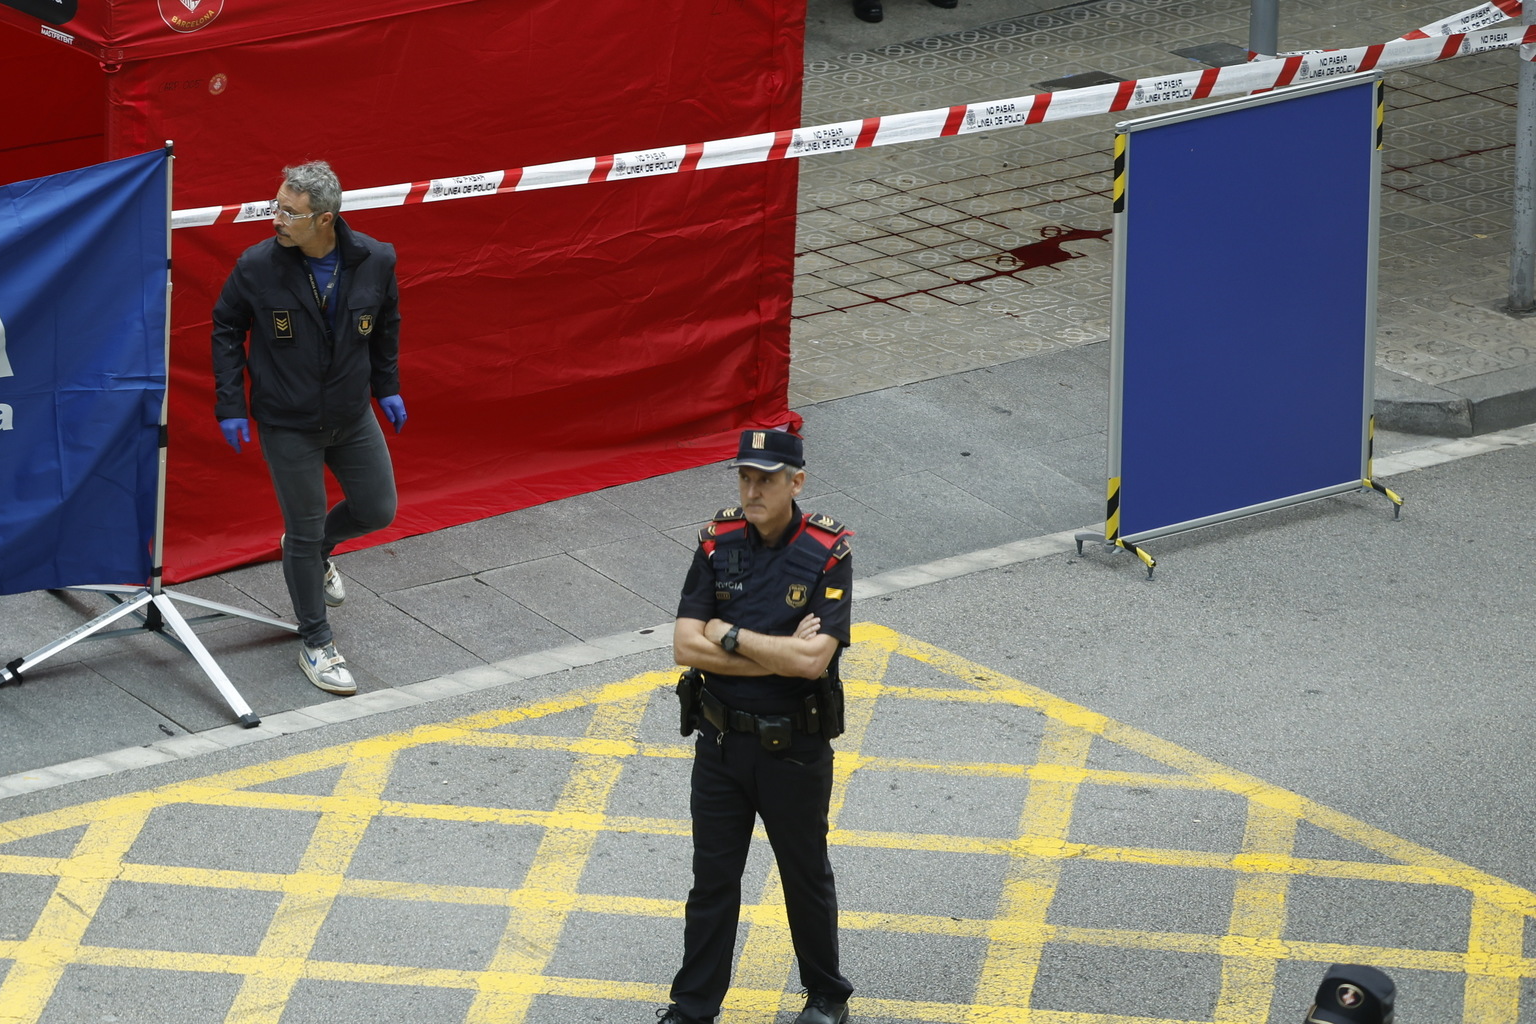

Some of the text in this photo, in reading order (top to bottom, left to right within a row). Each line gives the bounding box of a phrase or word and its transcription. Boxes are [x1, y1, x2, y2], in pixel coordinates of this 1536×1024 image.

[171, 9, 215, 28] BARCELONA
[1460, 7, 1491, 25] NO PASAR
[1481, 33, 1507, 44] NO PASAR
[1320, 55, 1347, 66] NO PASAR
[1309, 65, 1356, 78] LINEA DE POLICIA
[1154, 79, 1183, 91] NO PASAR
[1145, 88, 1192, 103] LINEA DE POLICIA
[986, 103, 1015, 115] NO PASAR
[977, 113, 1025, 128] LINEA DE POLICIA
[813, 127, 843, 139] NO PASAR
[805, 137, 853, 152] LINEA DE POLICIA
[626, 160, 677, 175] LINEA DE POLICIA
[443, 182, 496, 196] LINEA DE POLICIA
[256, 207, 272, 217] LINE
